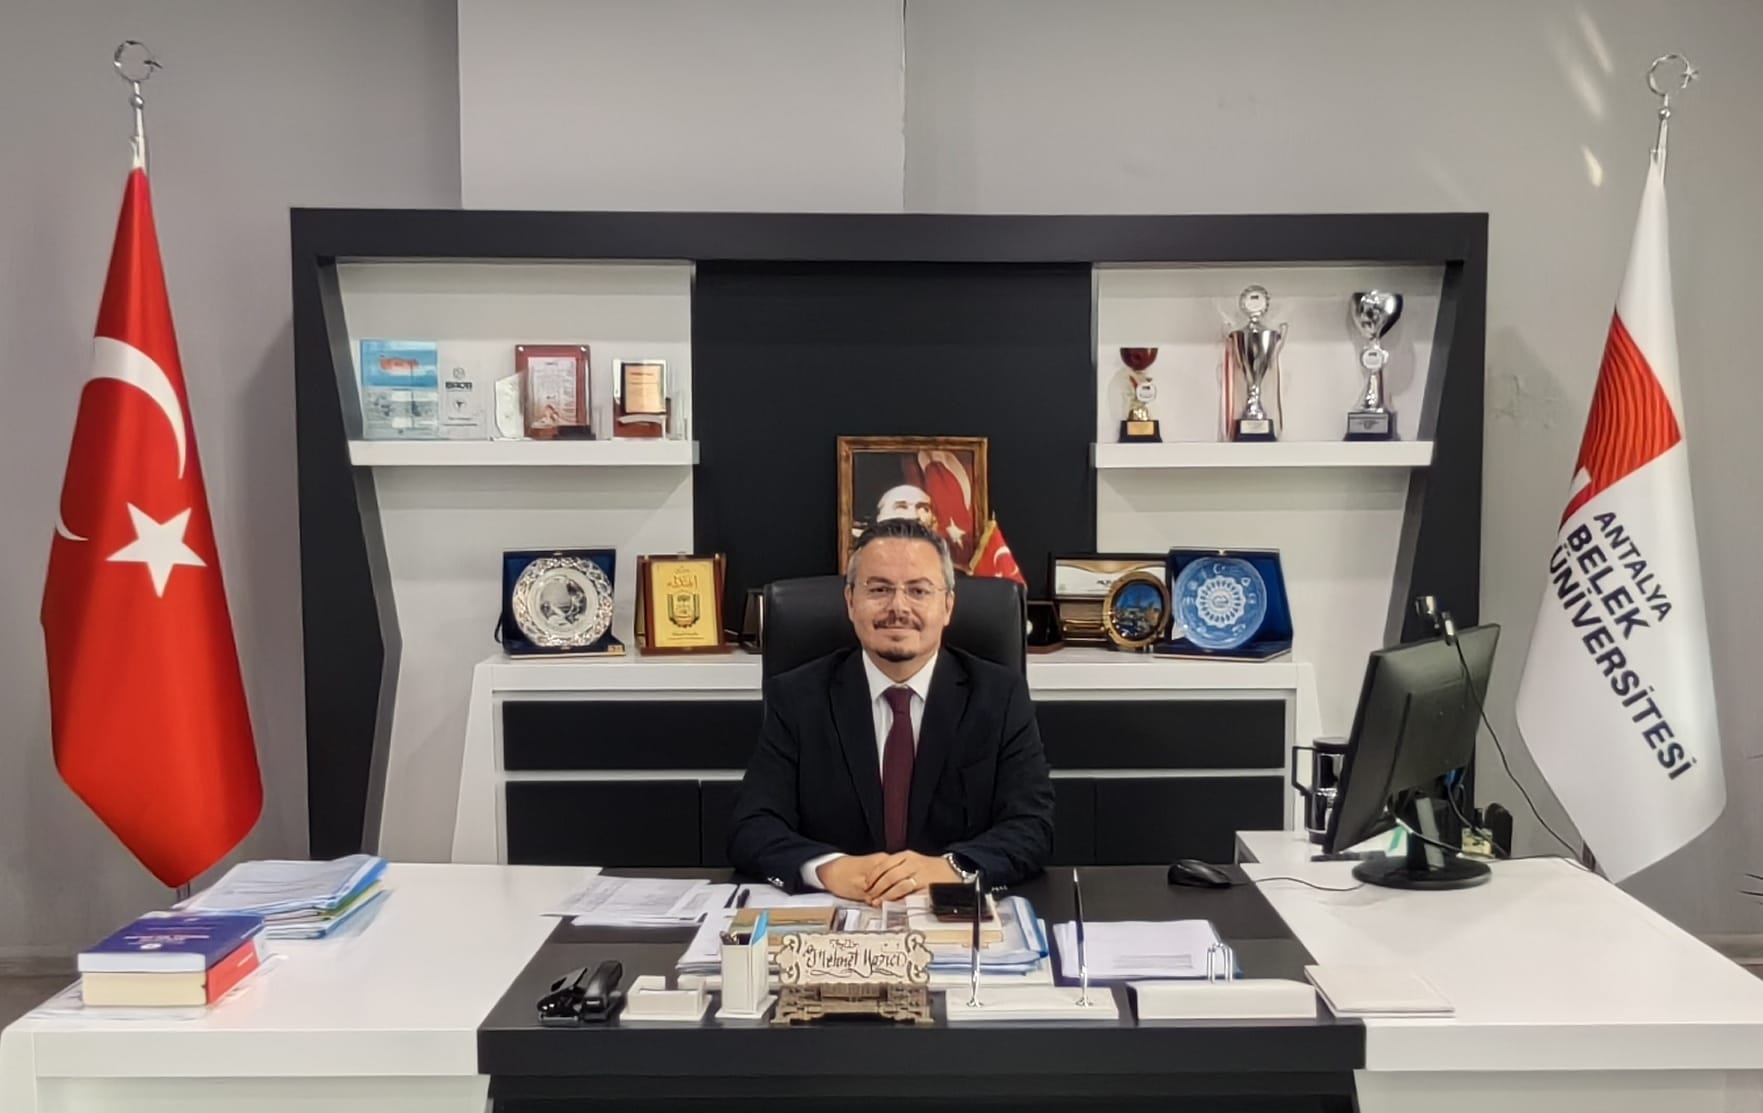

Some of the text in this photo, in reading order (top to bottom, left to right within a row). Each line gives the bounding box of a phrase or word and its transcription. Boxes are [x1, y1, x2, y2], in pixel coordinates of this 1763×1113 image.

[1566, 523, 1650, 640] BELEK
[1593, 511, 1673, 621] ANTALYA
[1548, 542, 1697, 780] ÜNİVERSİTESİ
